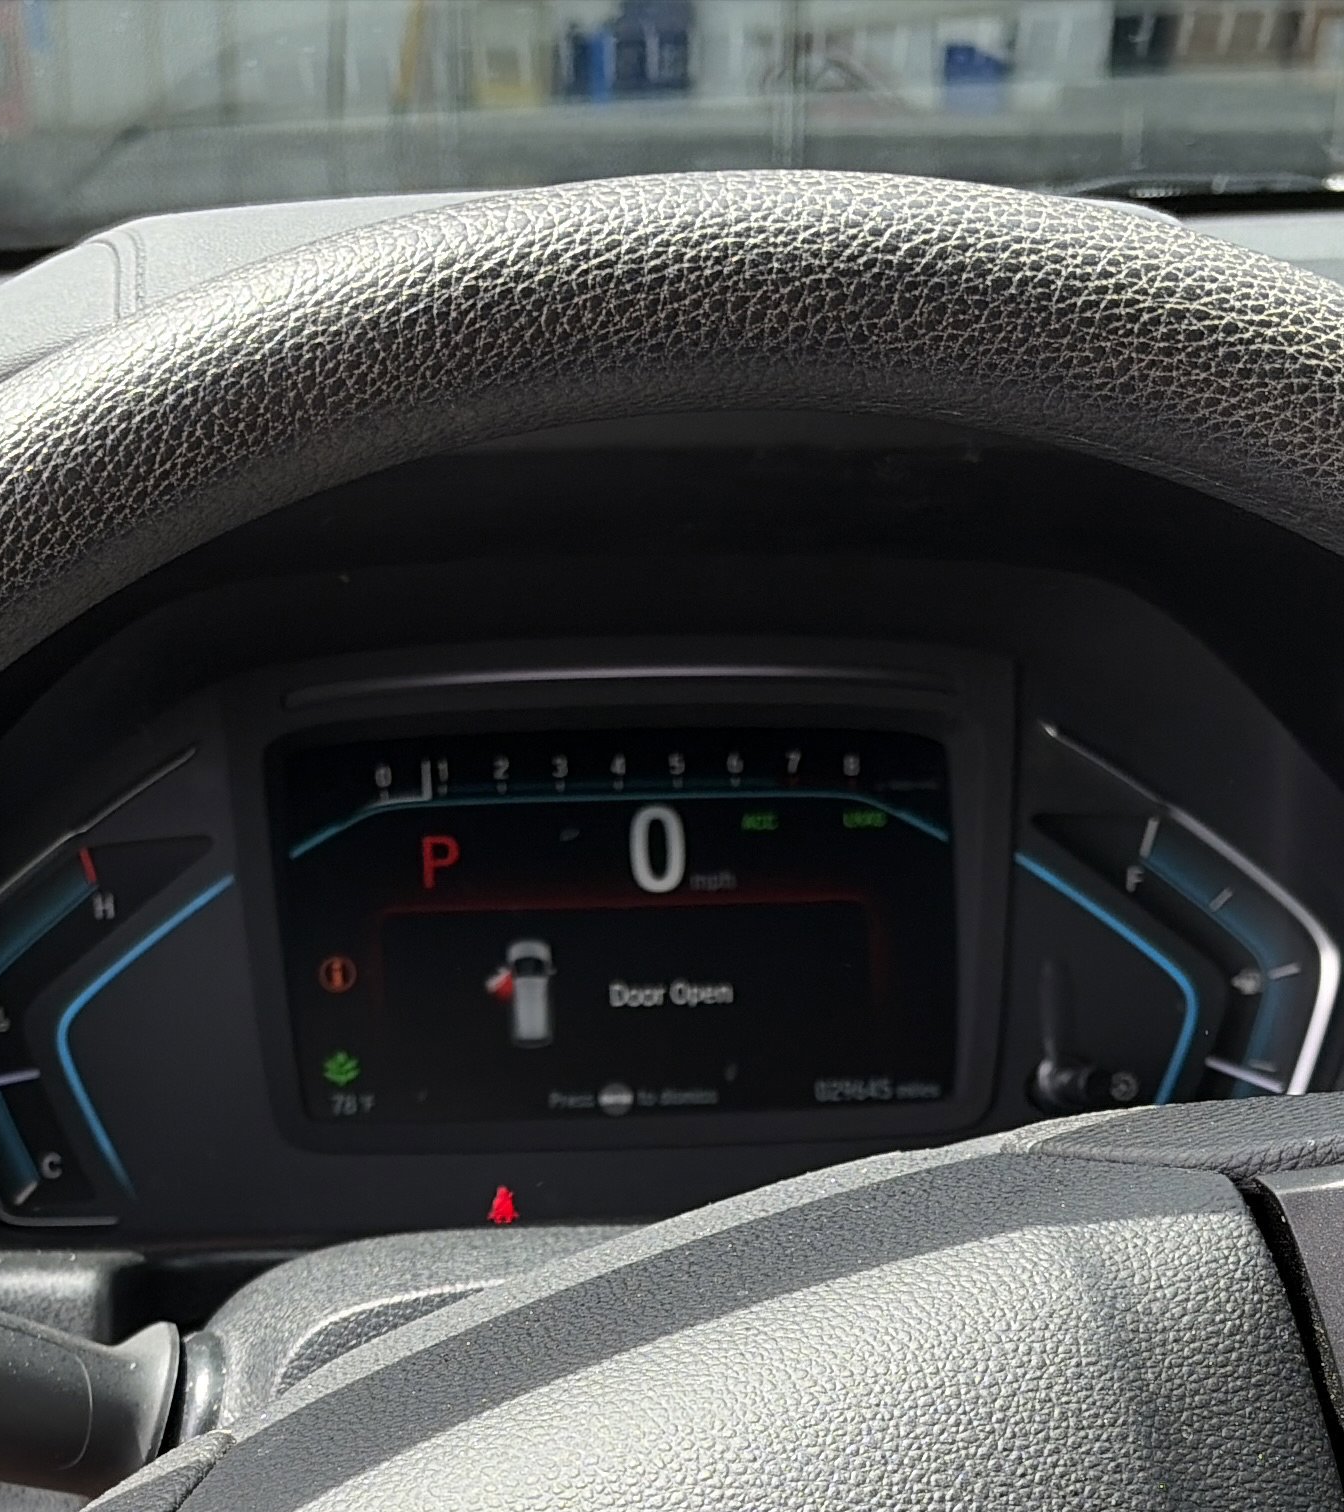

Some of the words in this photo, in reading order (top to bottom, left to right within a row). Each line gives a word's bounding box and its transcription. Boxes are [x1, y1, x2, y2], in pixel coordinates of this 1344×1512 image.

[375, 764, 392, 787] 0
[493, 756, 509, 780] 2
[552, 755, 568, 778] 3
[610, 754, 626, 775] 4
[668, 753, 686, 775] 5
[726, 753, 744, 774] 6
[786, 750, 801, 773] 7
[843, 753, 860, 776] 8
[422, 836, 460, 889] P
[629, 805, 686, 893] 0
[93, 893, 116, 920] H
[609, 983, 665, 1007] Door
[670, 980, 734, 1007] Open
[41, 1152, 62, 1179] C
